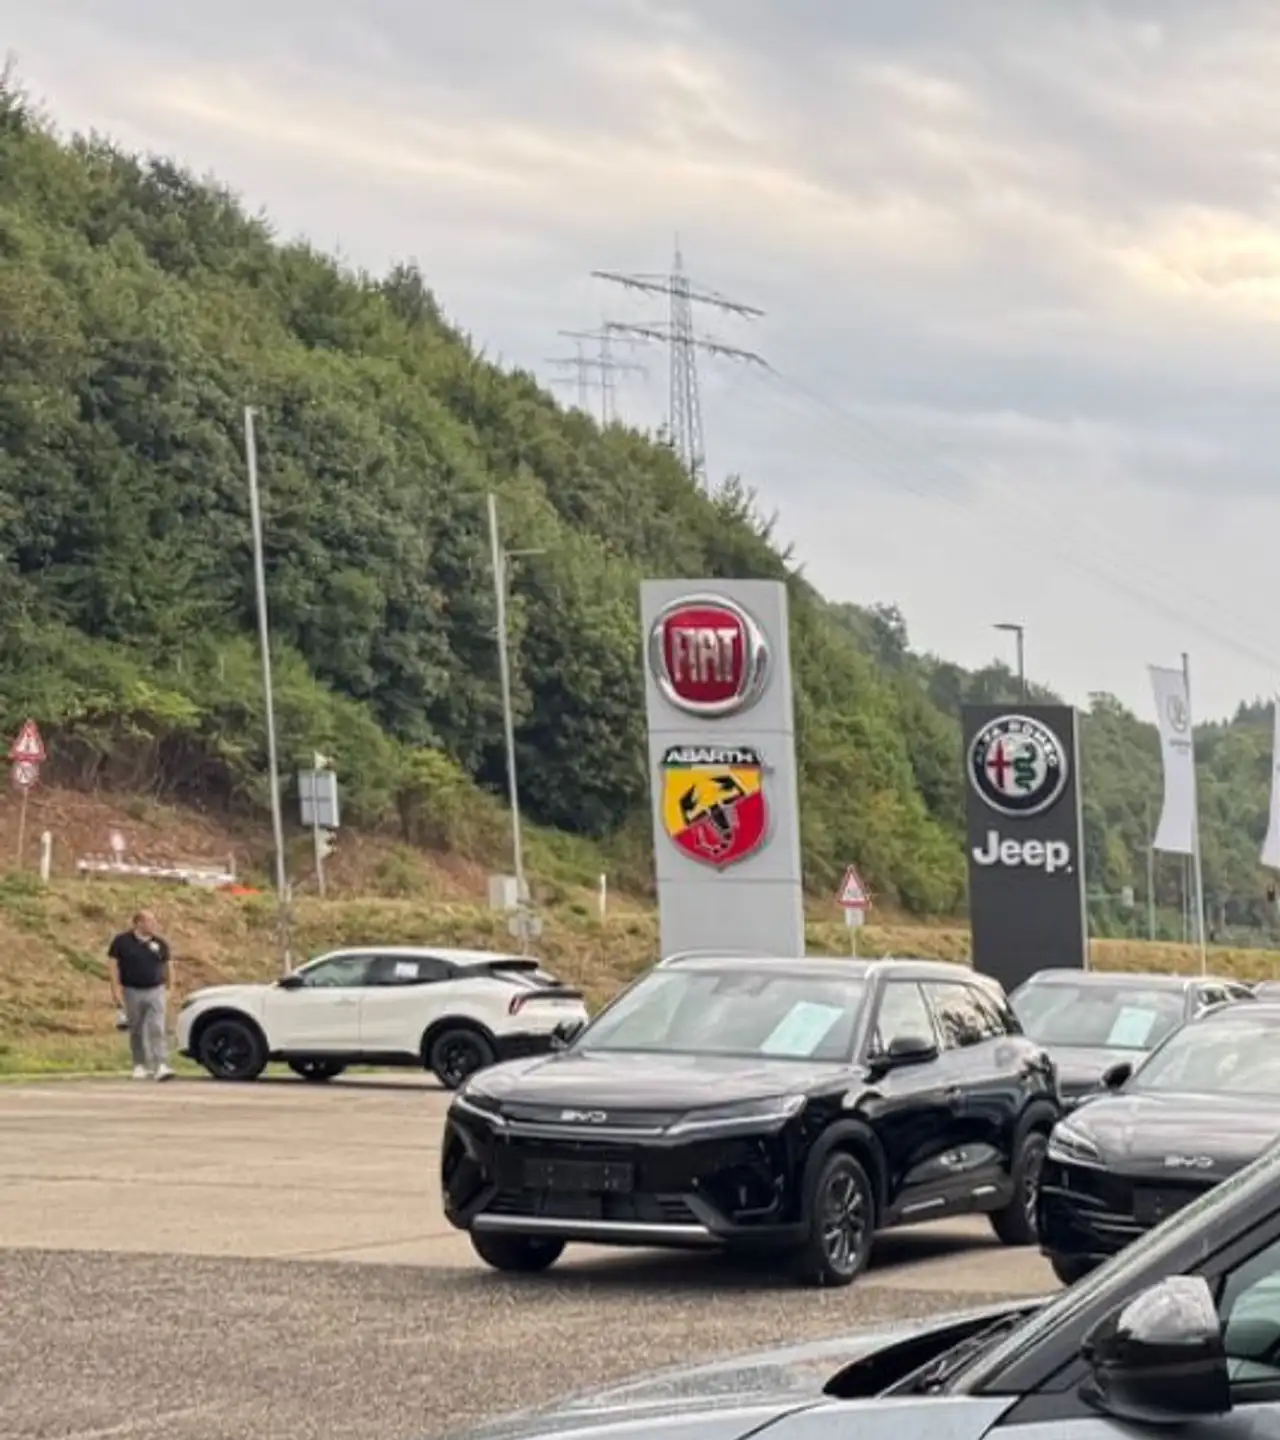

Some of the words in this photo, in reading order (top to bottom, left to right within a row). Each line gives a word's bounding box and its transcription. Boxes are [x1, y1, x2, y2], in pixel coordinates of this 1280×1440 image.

[670, 626, 738, 683] FIAT
[666, 749, 754, 763] ABARTH
[972, 829, 1070, 873] Jeep
